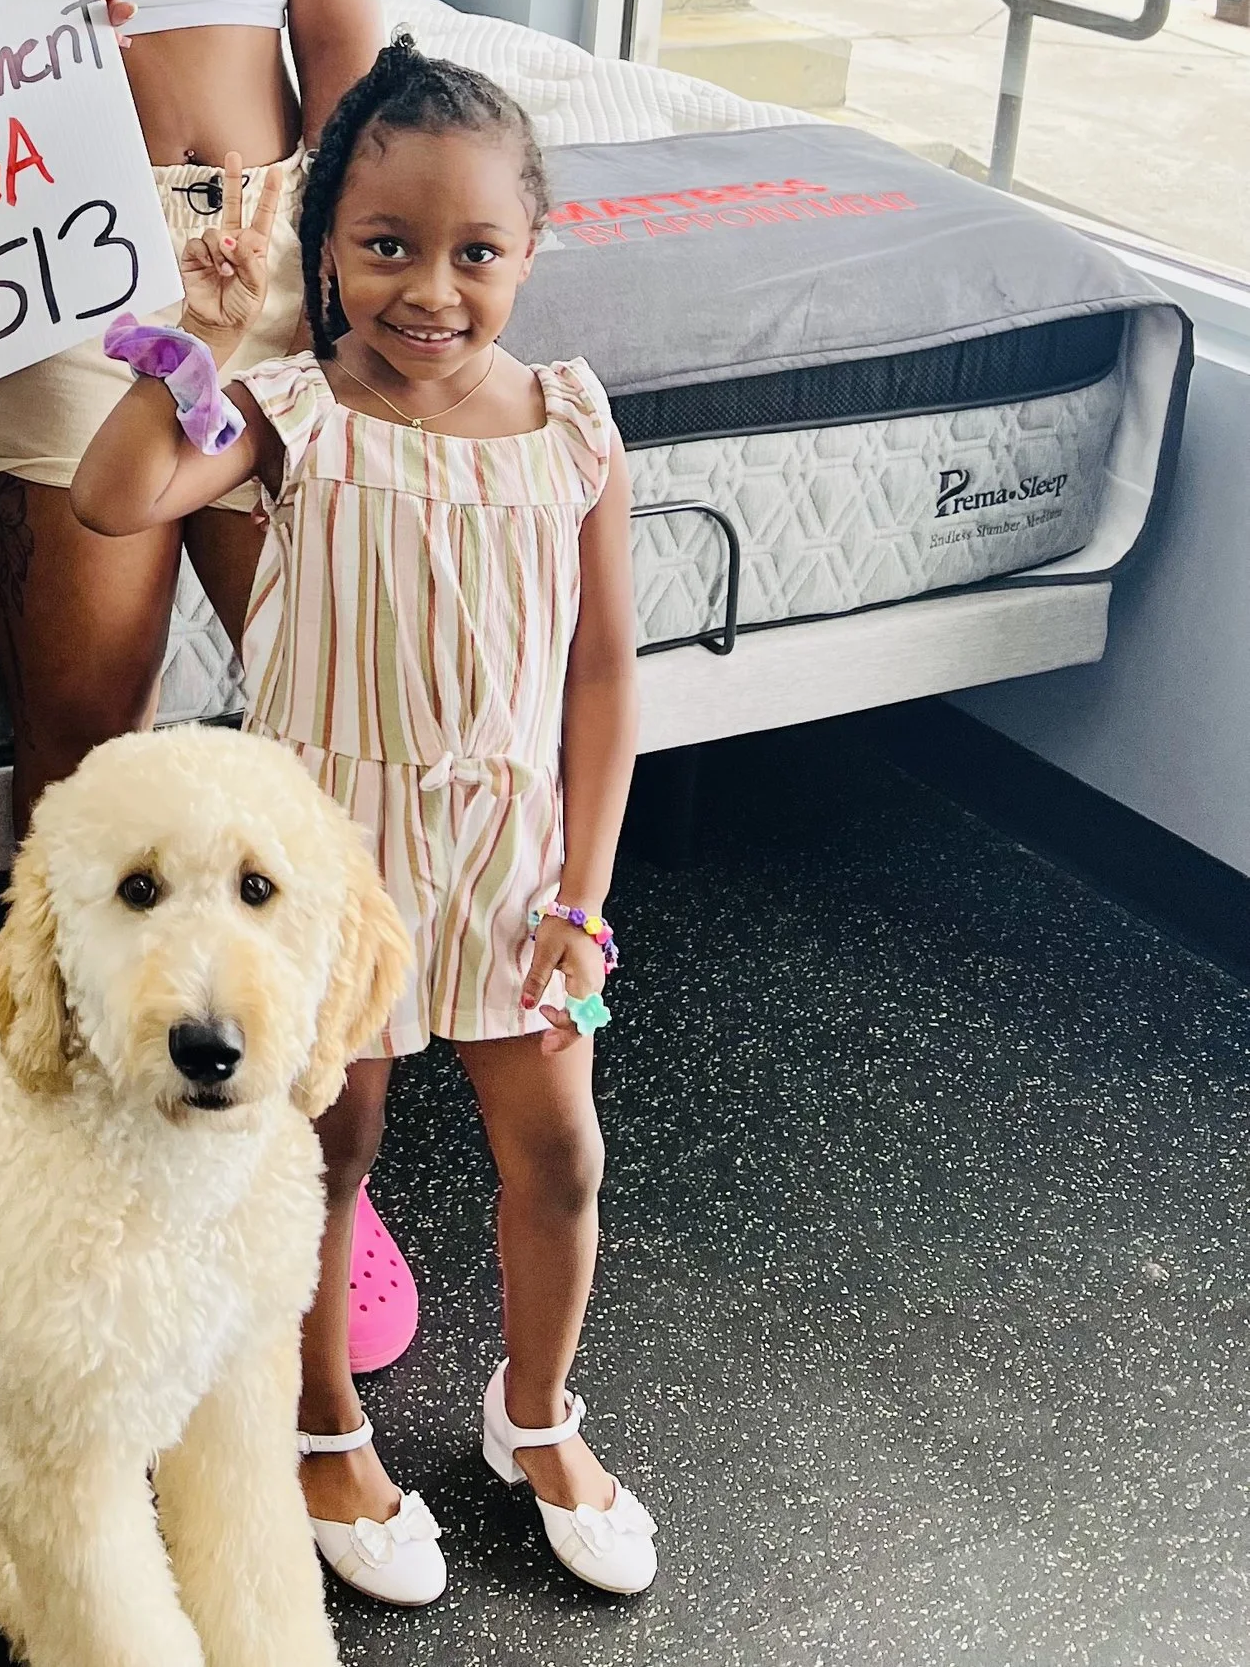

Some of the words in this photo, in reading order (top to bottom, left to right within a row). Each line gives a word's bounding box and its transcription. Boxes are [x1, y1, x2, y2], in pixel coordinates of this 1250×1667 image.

[547, 179, 828, 226] MATTRESS
[570, 221, 630, 246] BY
[641, 191, 919, 238] APPOINTMENT
[976, 520, 1022, 538] Slumber
